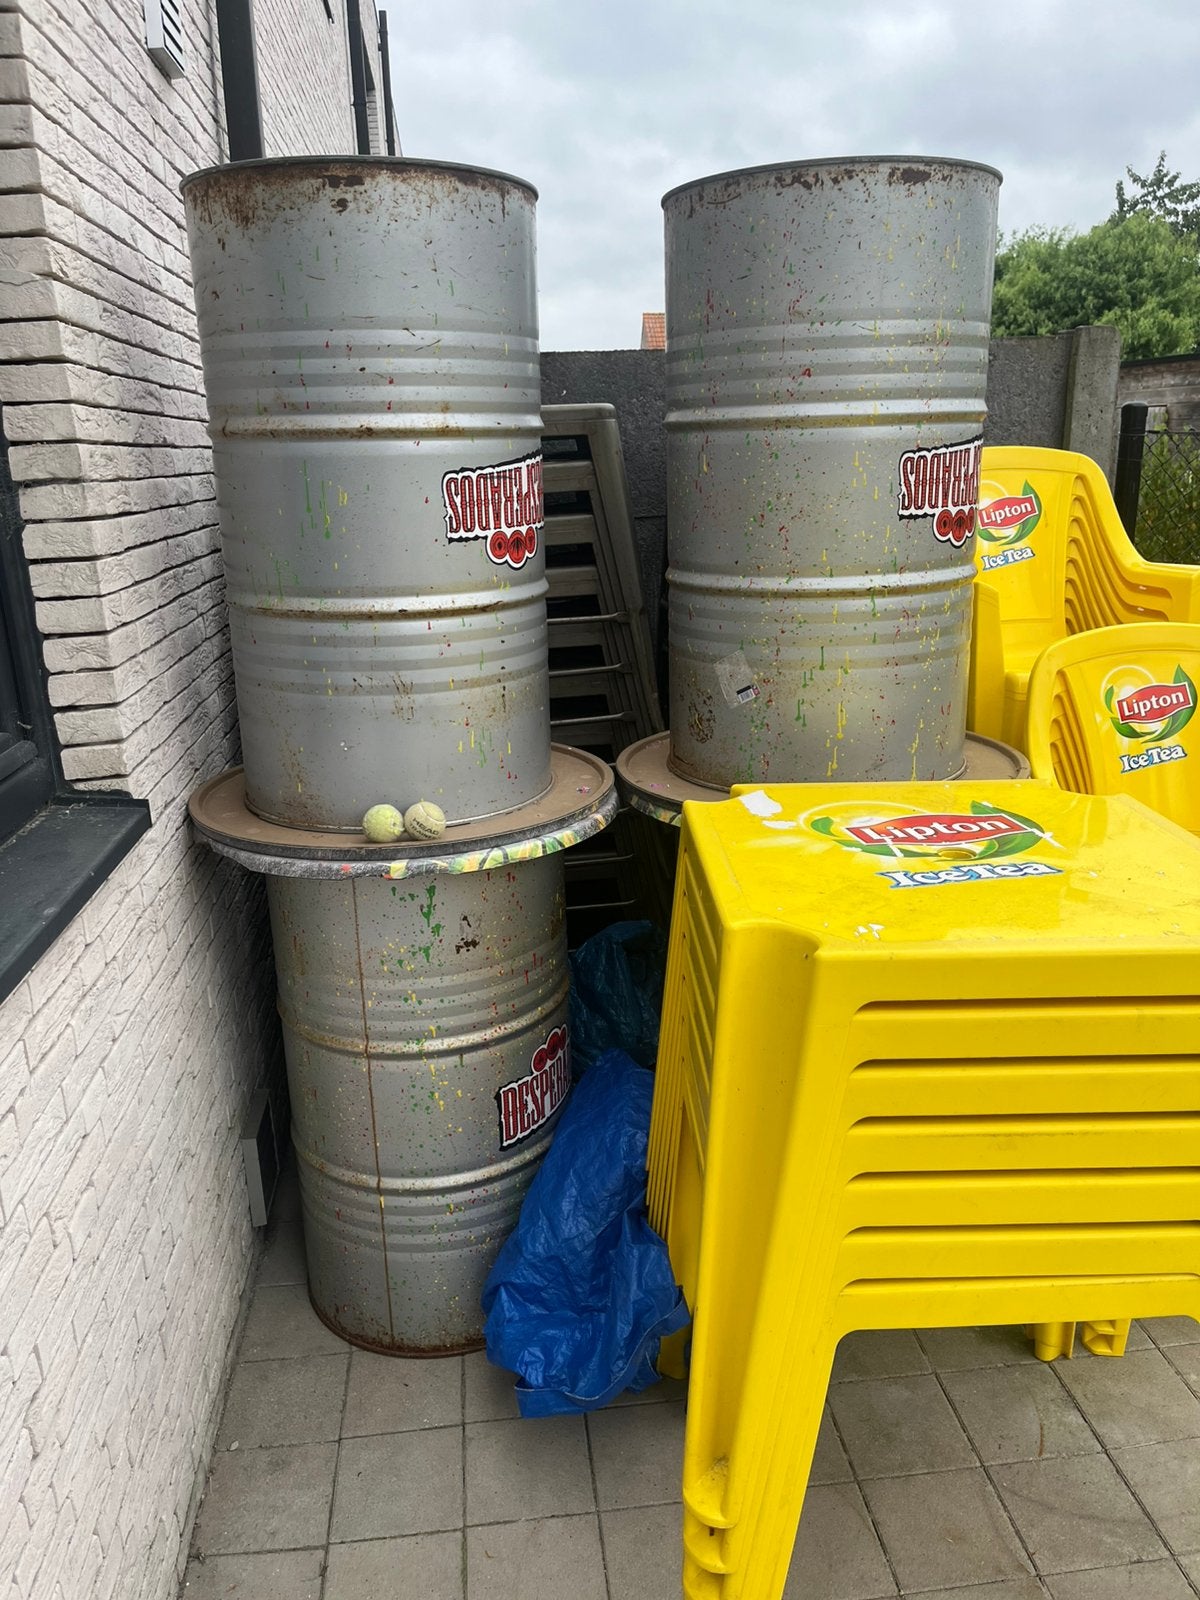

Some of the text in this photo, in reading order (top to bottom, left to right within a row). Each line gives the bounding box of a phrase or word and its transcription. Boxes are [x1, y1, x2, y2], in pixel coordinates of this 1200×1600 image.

[982, 501, 1033, 525] Lipton
[1121, 691, 1185, 717] Lipton
[413, 817, 440, 836] HEAD
[860, 818, 1010, 842] Lipton
